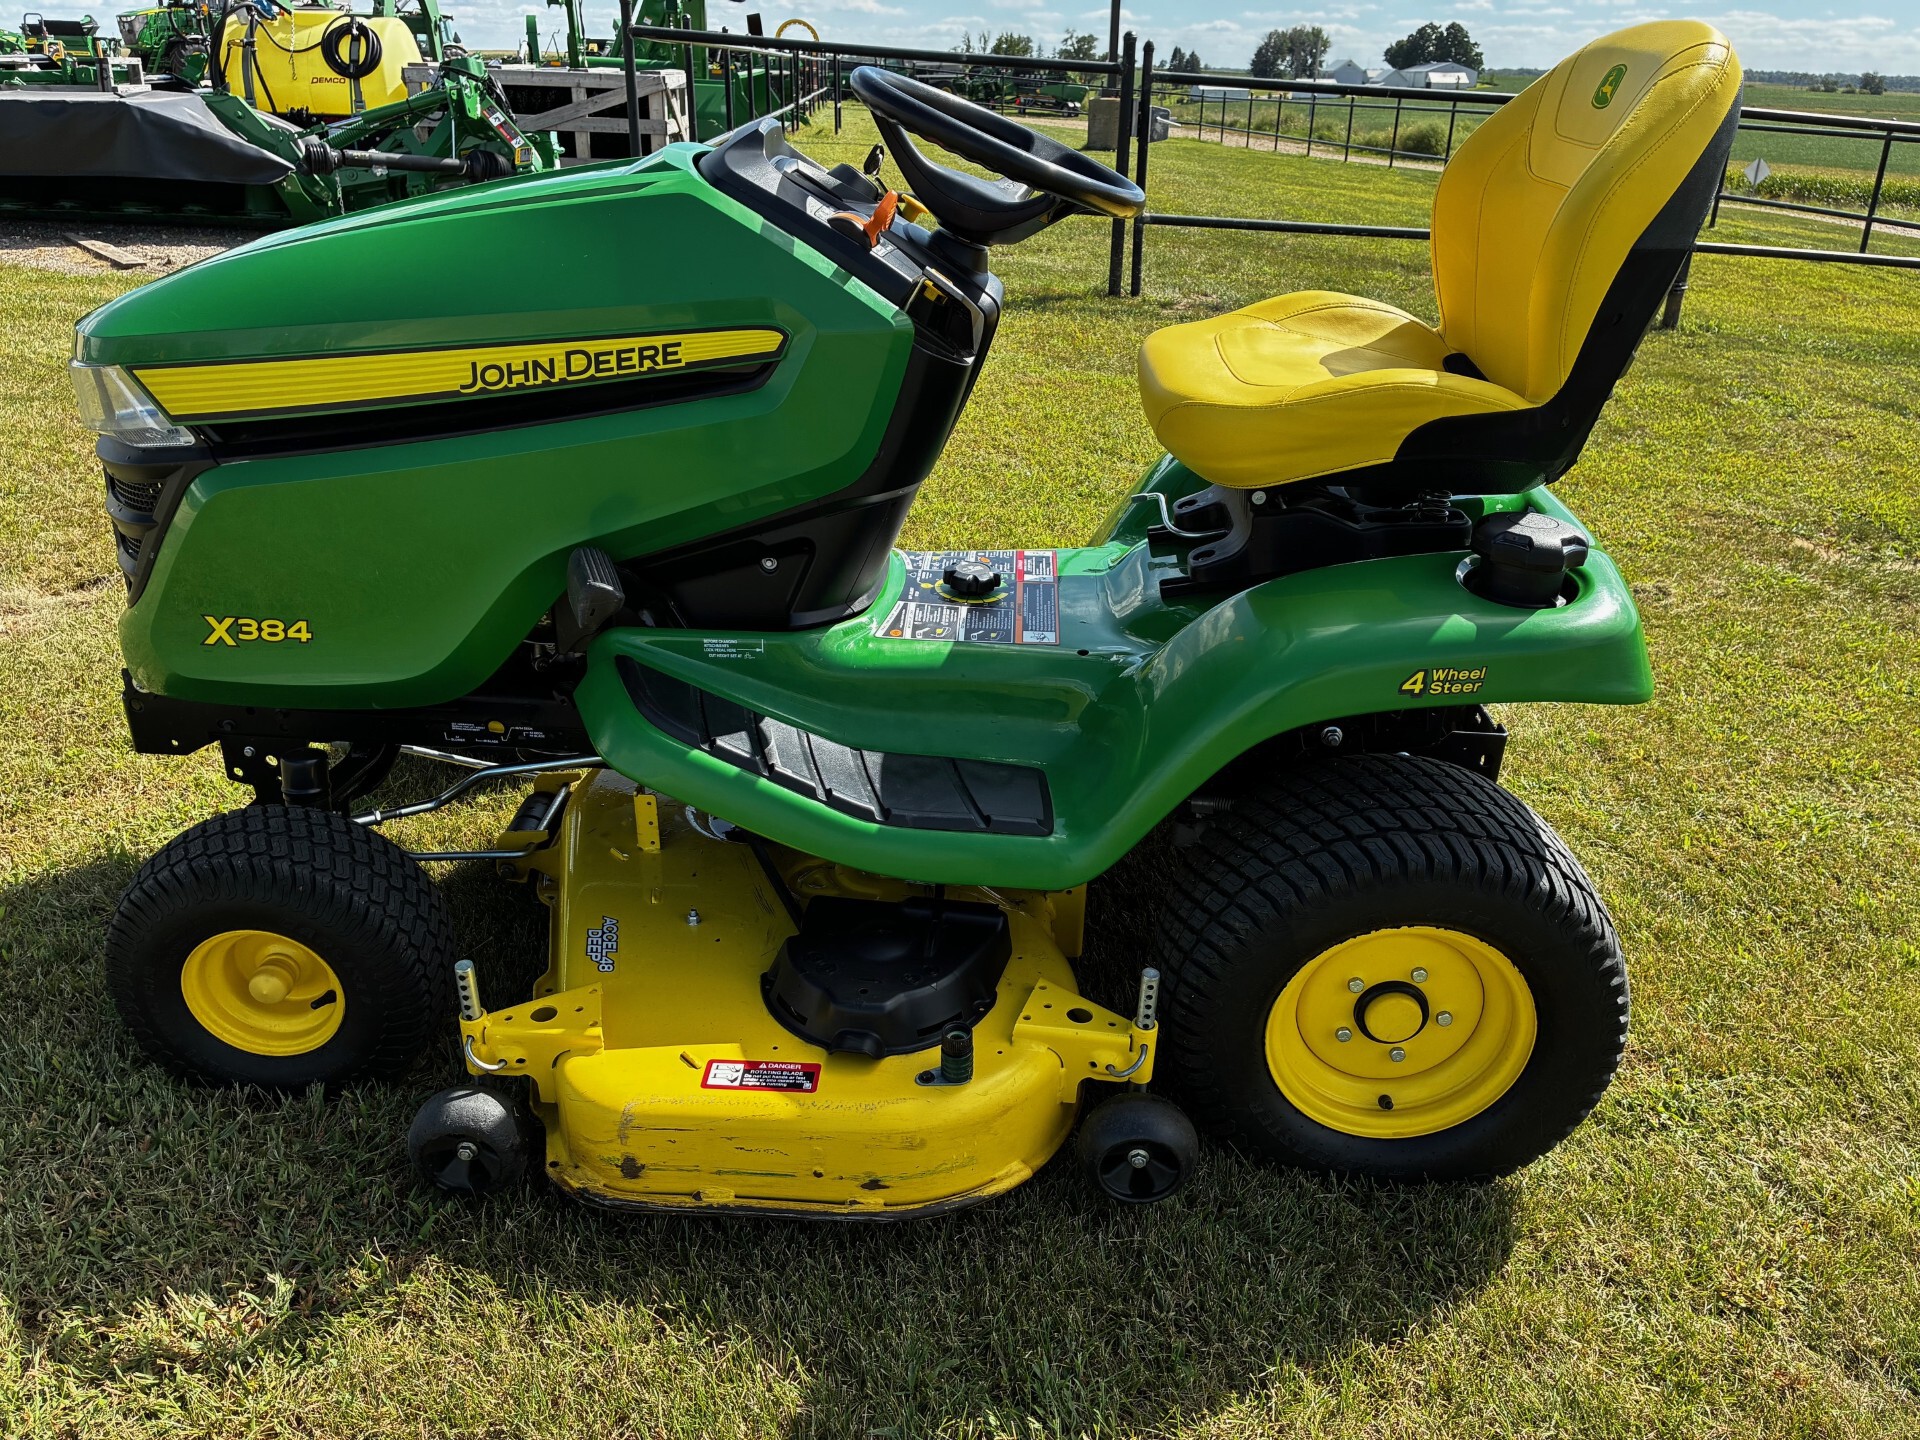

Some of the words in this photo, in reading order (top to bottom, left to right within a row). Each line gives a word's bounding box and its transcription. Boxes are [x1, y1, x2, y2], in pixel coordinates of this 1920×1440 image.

[310, 76, 346, 84] DEMCO
[459, 357, 556, 390] JOHN
[564, 341, 683, 377] DEERE
[202, 614, 313, 646] X384
[1400, 670, 1425, 694] 4
[1432, 667, 1487, 681] Wheel
[1428, 681, 1482, 694] Steer
[586, 929, 603, 962] DEEP
